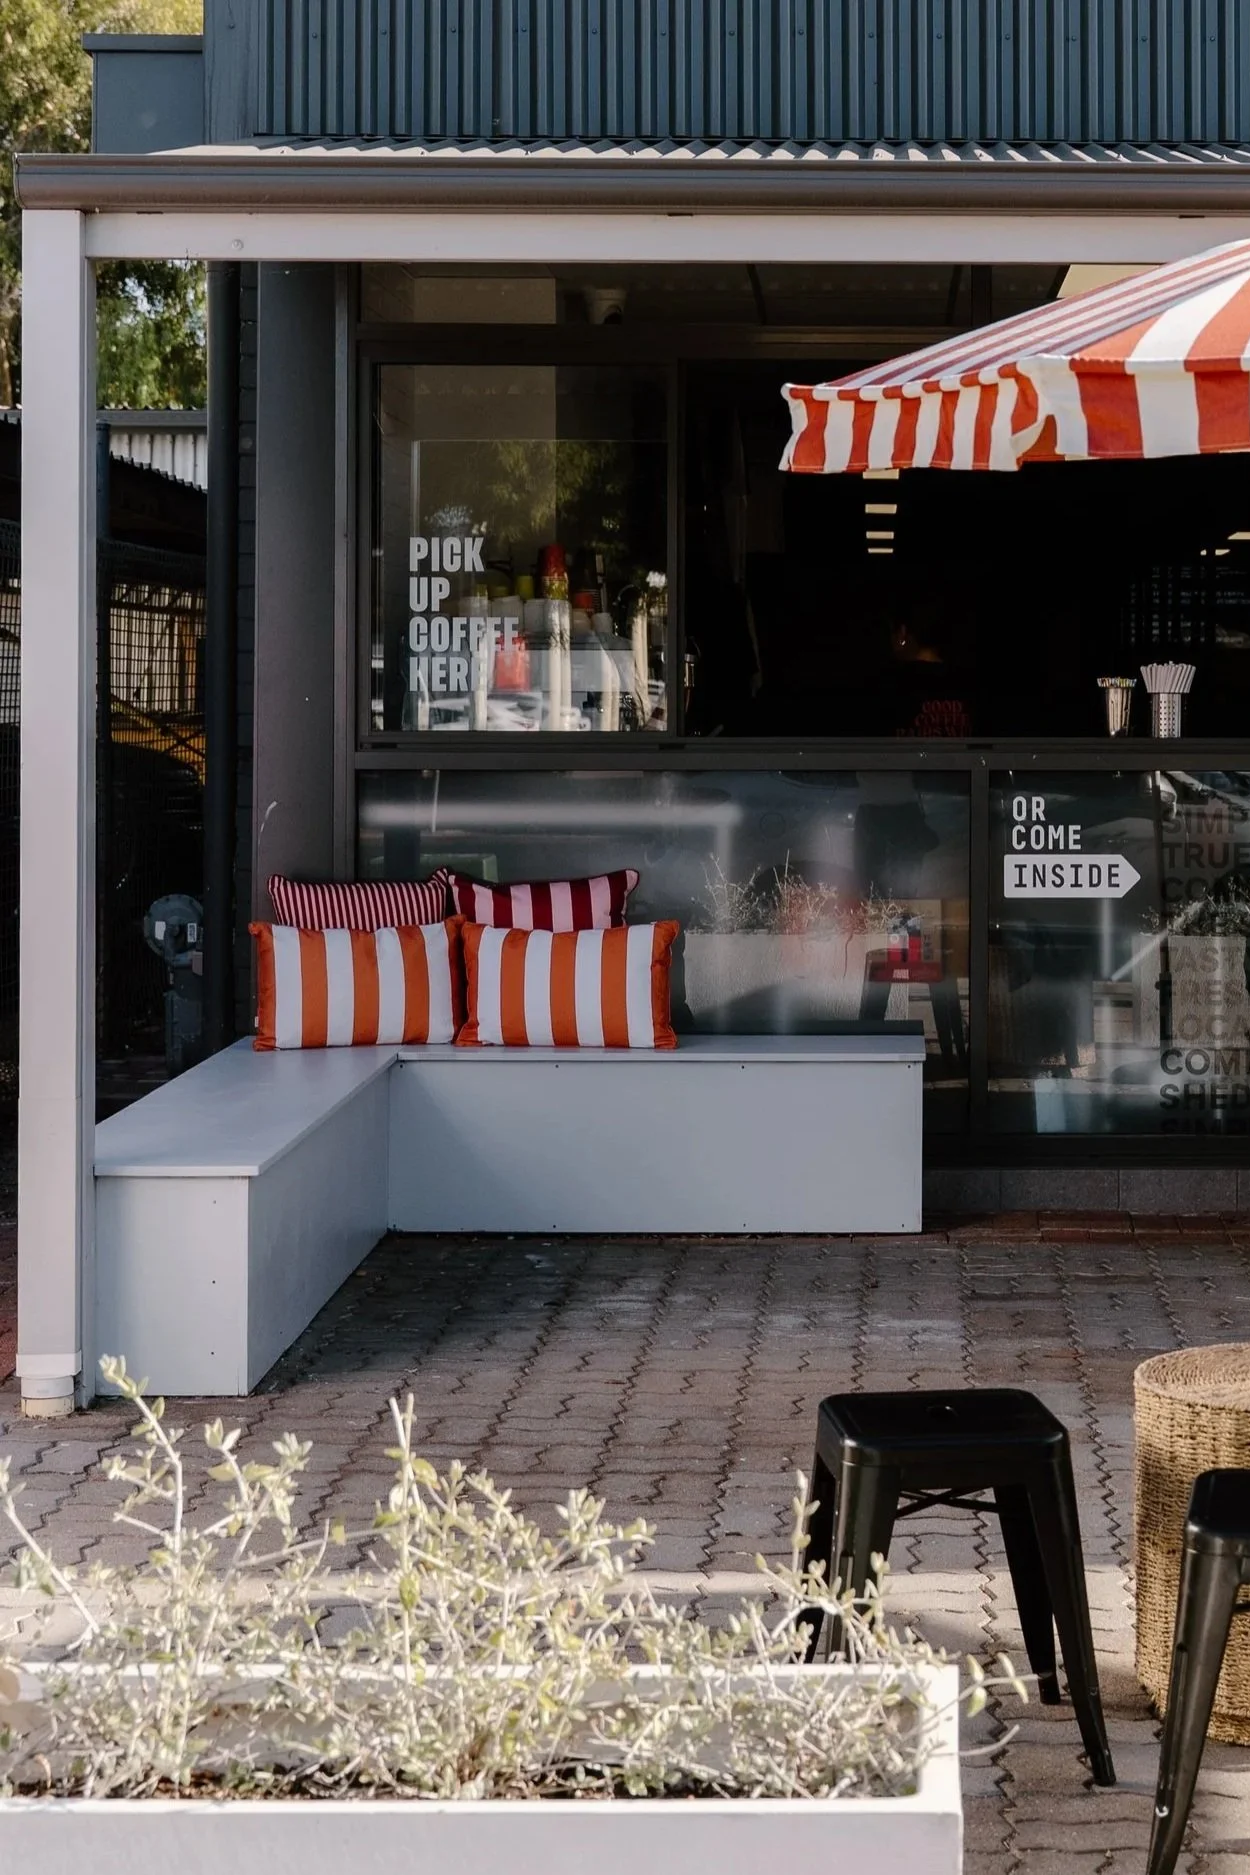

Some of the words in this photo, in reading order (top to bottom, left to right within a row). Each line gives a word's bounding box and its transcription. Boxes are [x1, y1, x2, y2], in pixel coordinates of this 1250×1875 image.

[409, 536, 485, 573] PICK
[409, 577, 451, 612] UP
[409, 616, 520, 652] COFFEE
[1012, 796, 1046, 822] OR
[1012, 825, 1082, 851] COME
[1013, 864, 1121, 889] INSIDE
